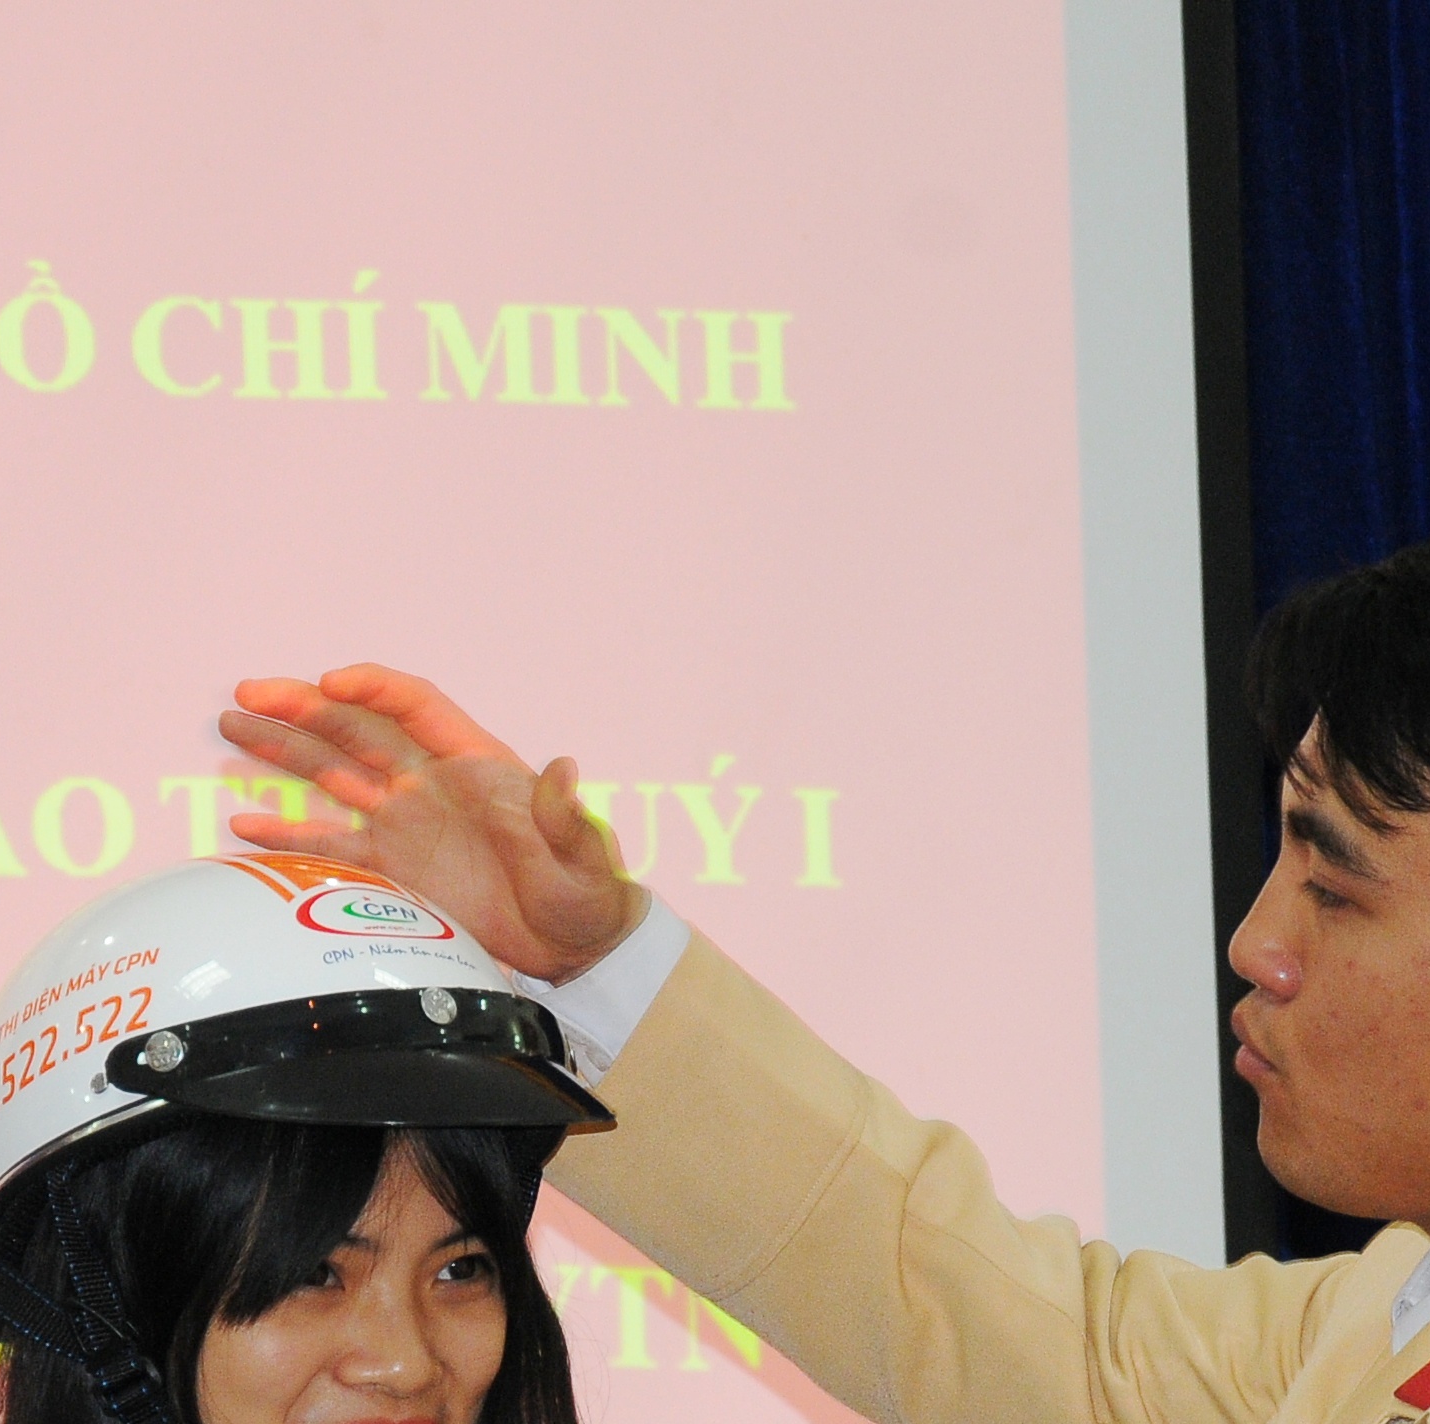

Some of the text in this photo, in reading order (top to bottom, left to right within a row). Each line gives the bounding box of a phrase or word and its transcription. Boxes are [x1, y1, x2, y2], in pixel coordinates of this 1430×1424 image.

[131, 268, 389, 401] CHÍ
[417, 300, 796, 412] MINH
[574, 754, 763, 886] UÝ
[793, 787, 841, 889] I
[362, 903, 419, 922] CPN
[21, 984, 64, 1025] ĐIỆN
[65, 962, 111, 998] MÁY
[113, 947, 161, 975] CPN
[322, 947, 355, 966] CPN
